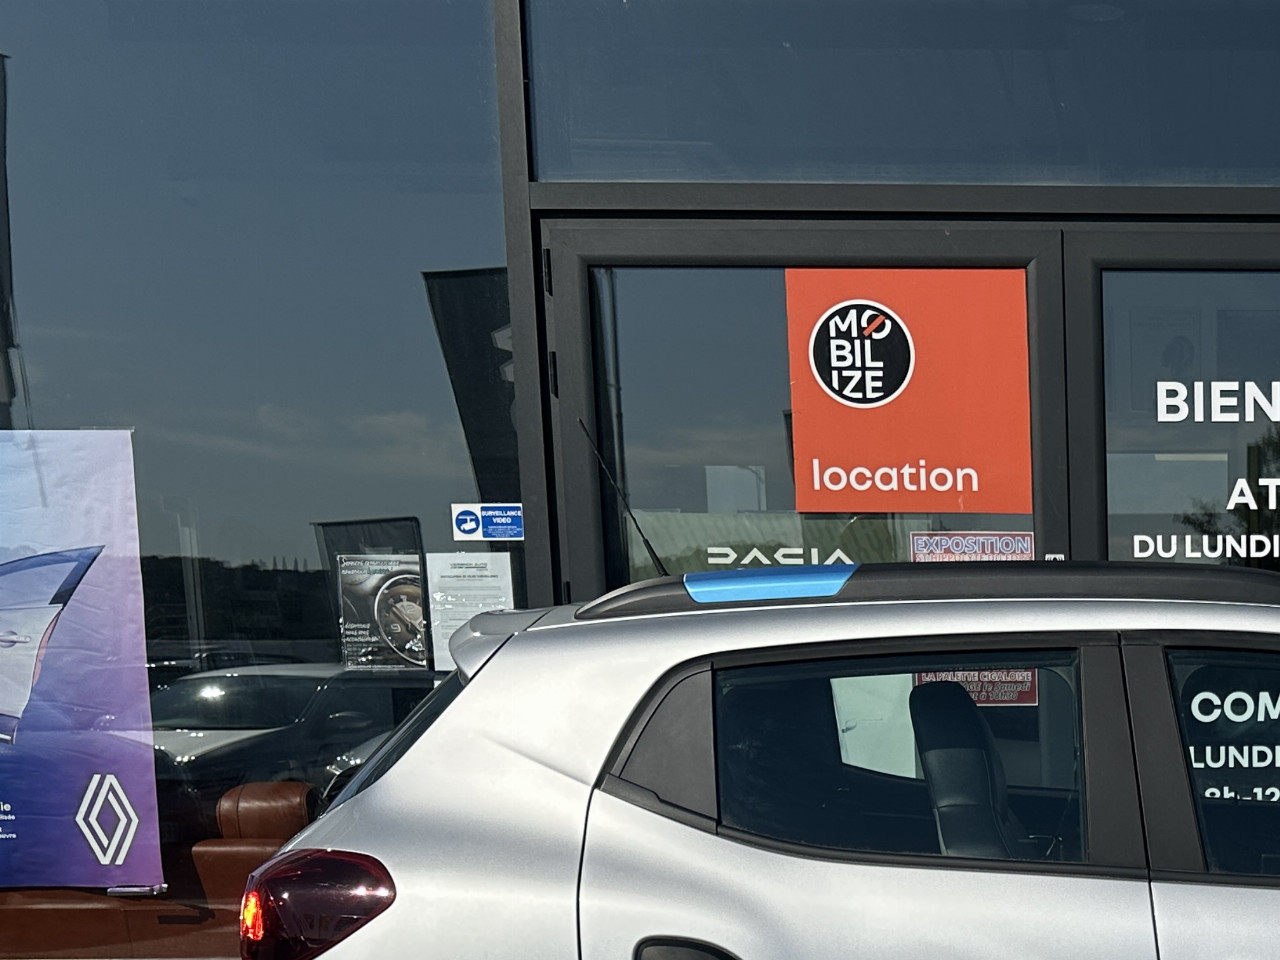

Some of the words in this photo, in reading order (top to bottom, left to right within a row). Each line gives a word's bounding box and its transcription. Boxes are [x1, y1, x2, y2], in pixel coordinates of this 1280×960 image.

[830, 339, 884, 368] BIL
[831, 370, 885, 399] IZE
[812, 458, 979, 492] location
[707, 547, 855, 565] DACIA
[914, 536, 1031, 554] EXPOSITION
[1133, 534, 1178, 559] DU
[1184, 534, 1280, 558] LUNDI
[937, 671, 979, 682] PALETTE
[979, 671, 1033, 682] CIGALOISE
